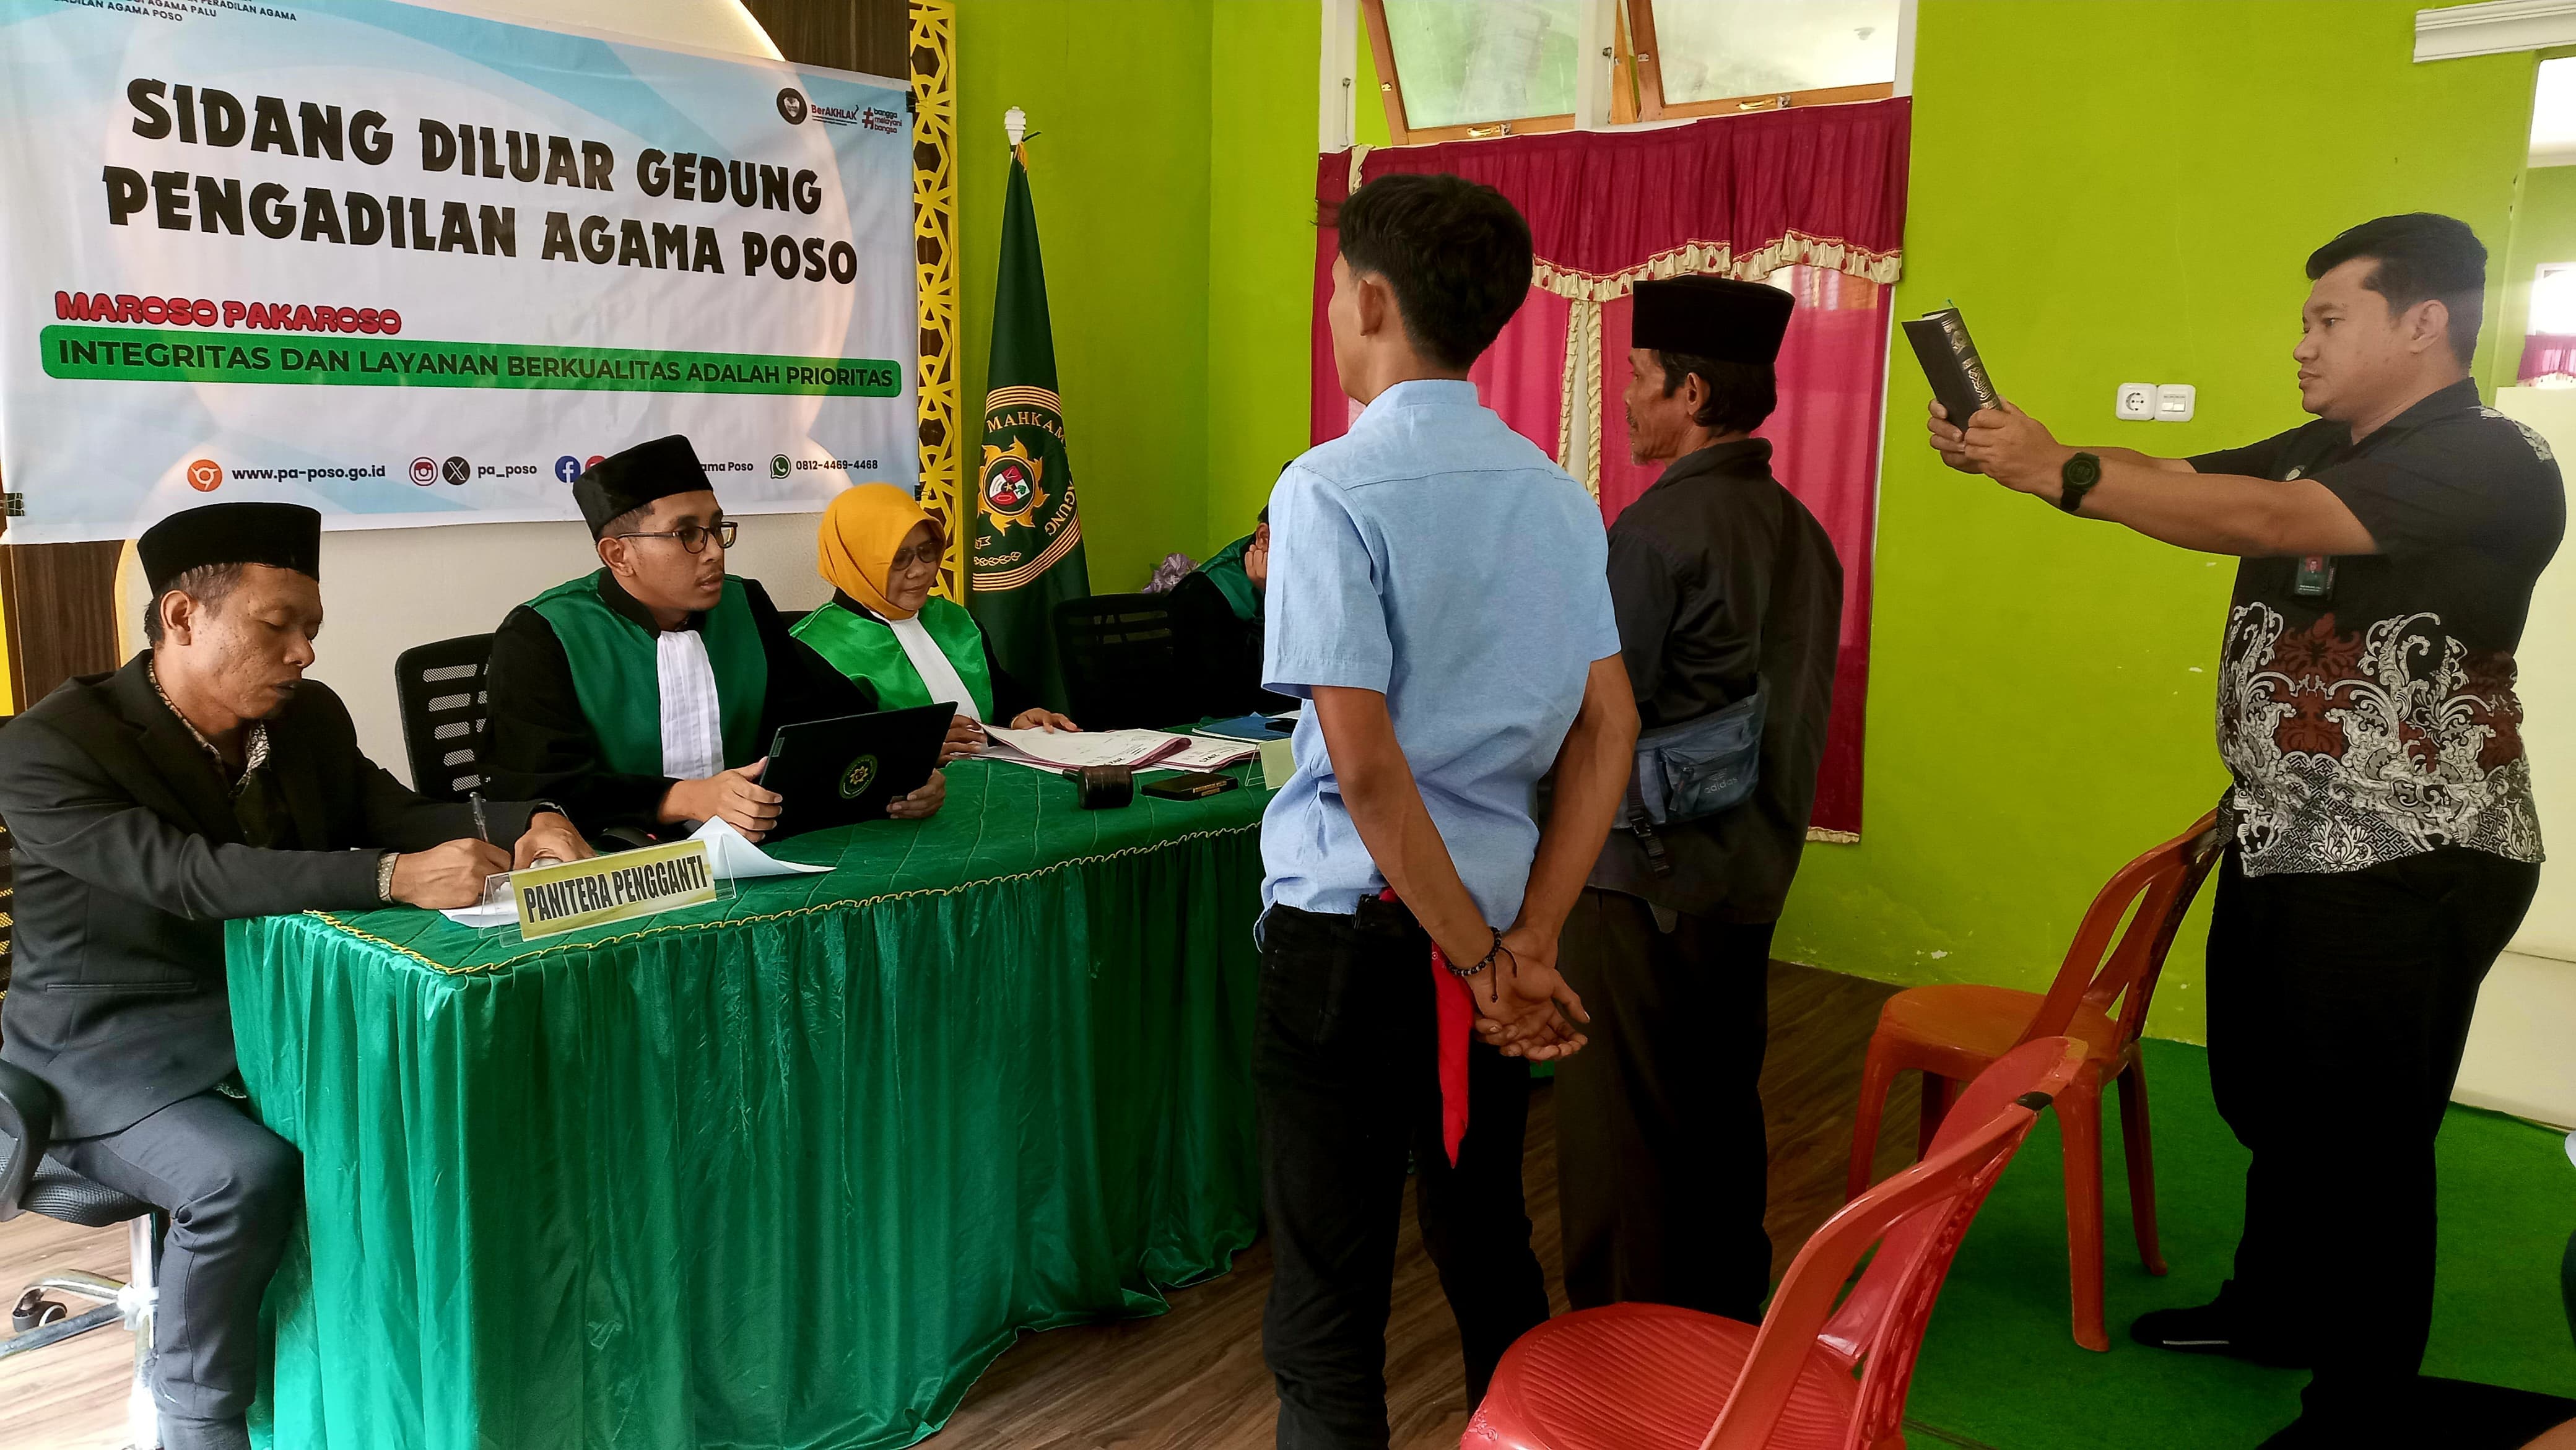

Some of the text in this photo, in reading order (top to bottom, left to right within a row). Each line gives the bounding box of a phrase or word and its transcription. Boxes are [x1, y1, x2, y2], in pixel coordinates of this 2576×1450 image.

[107, 2, 150, 16] AGAMA
[152, 9, 183, 22] POSO
[149, 0, 217, 17] AGAMA PALU
[260, 7, 297, 22] AGAMA
[811, 105, 859, 120] BerAKHLAK
[128, 79, 821, 214] SIDANG DILUAR GEDUNG
[102, 165, 857, 284] PENGADILAN AGAMA POSO
[54, 290, 402, 335] MAROSO PAKAROSO
[59, 339, 893, 387] INTEGRITAS DAN LAYANAN BERKUALITAS ADALAH PRIORITAS
[986, 411, 1066, 445] MAHKAM
[232, 465, 385, 482] www.pa-poso.go.id
[477, 466, 537, 479] pa_poso
[700, 462, 754, 472] ama Poso
[796, 459, 878, 471] 0812-4469-4468
[1704, 778, 1739, 793] adidas
[523, 855, 708, 923] PANITERA PENGGANTI
